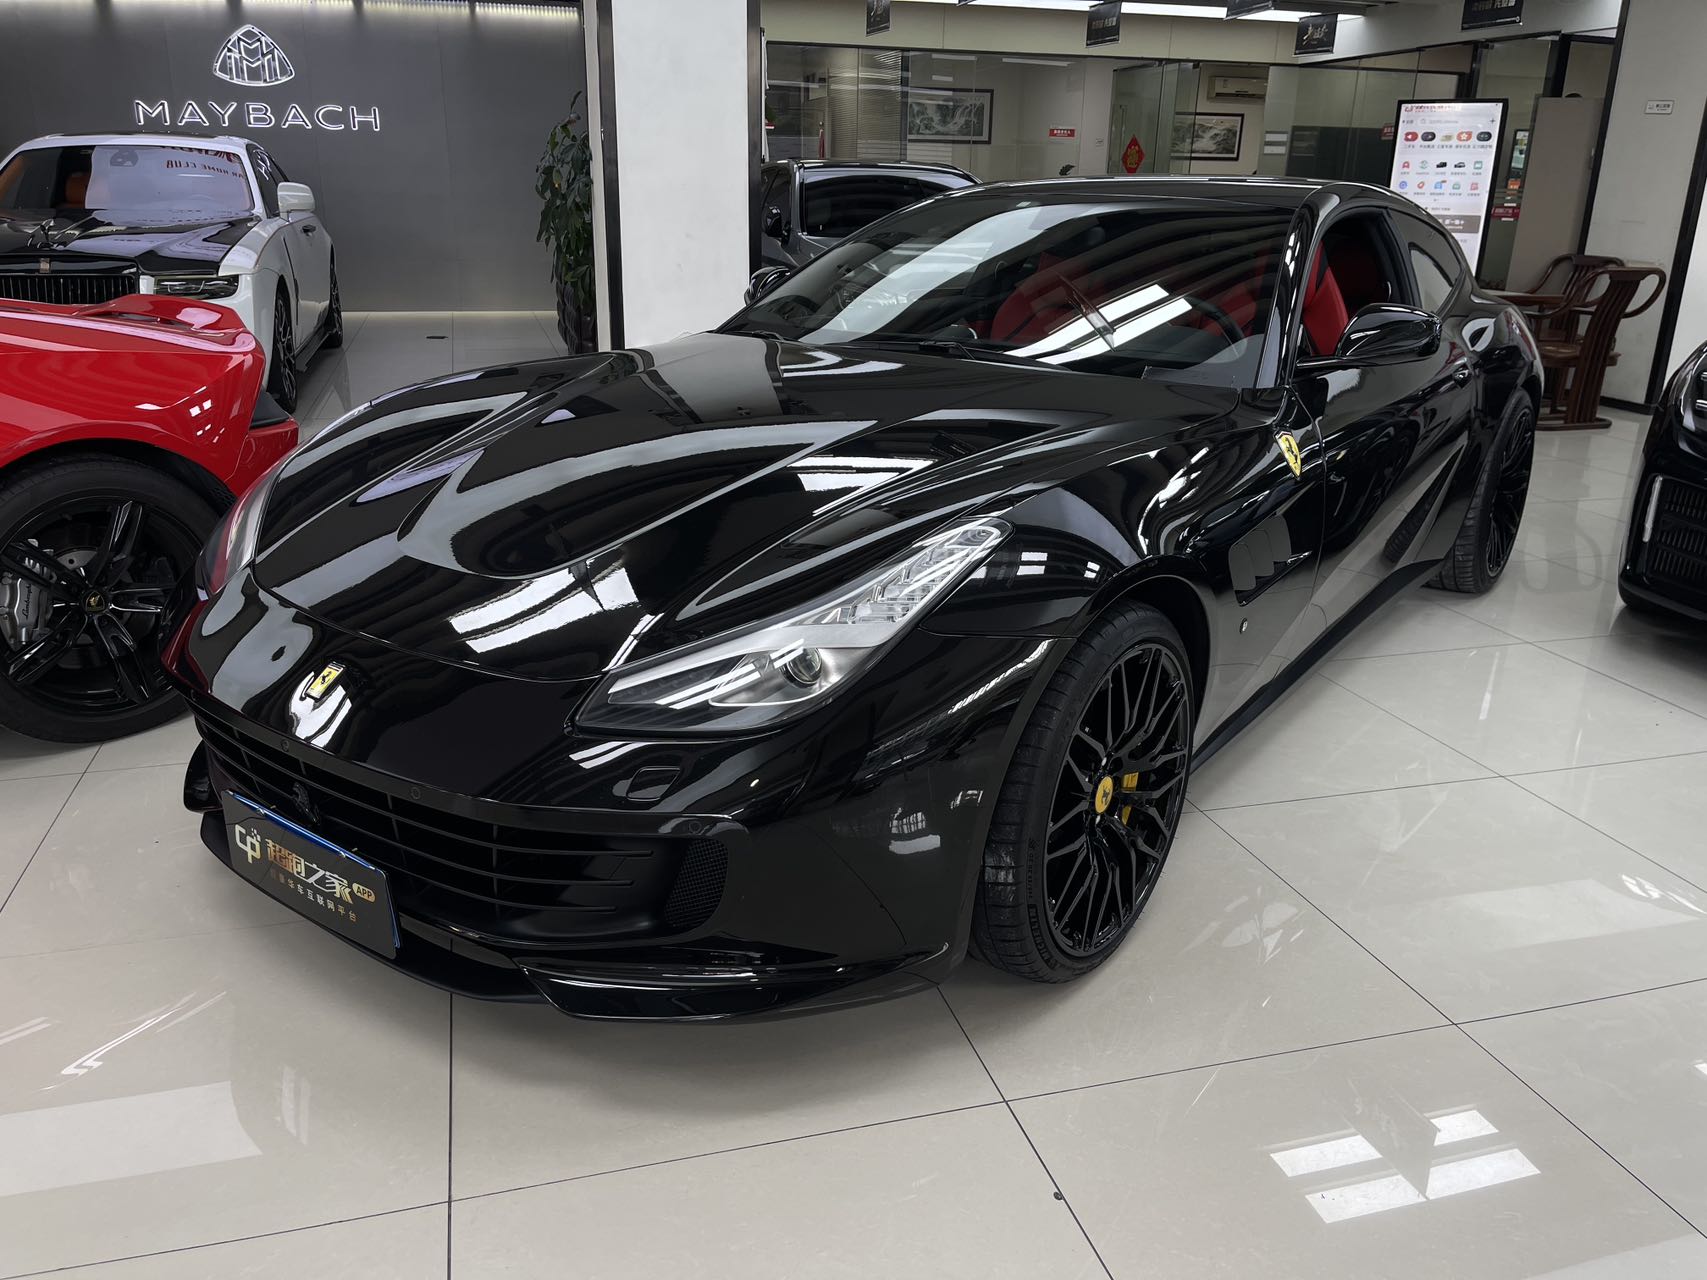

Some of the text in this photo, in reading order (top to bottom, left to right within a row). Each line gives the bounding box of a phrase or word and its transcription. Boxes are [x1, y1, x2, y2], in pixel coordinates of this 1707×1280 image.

[133, 100, 381, 131] MAYBACH
[355, 885, 374, 900] APP
[1028, 903, 1052, 961] MICHELIN
